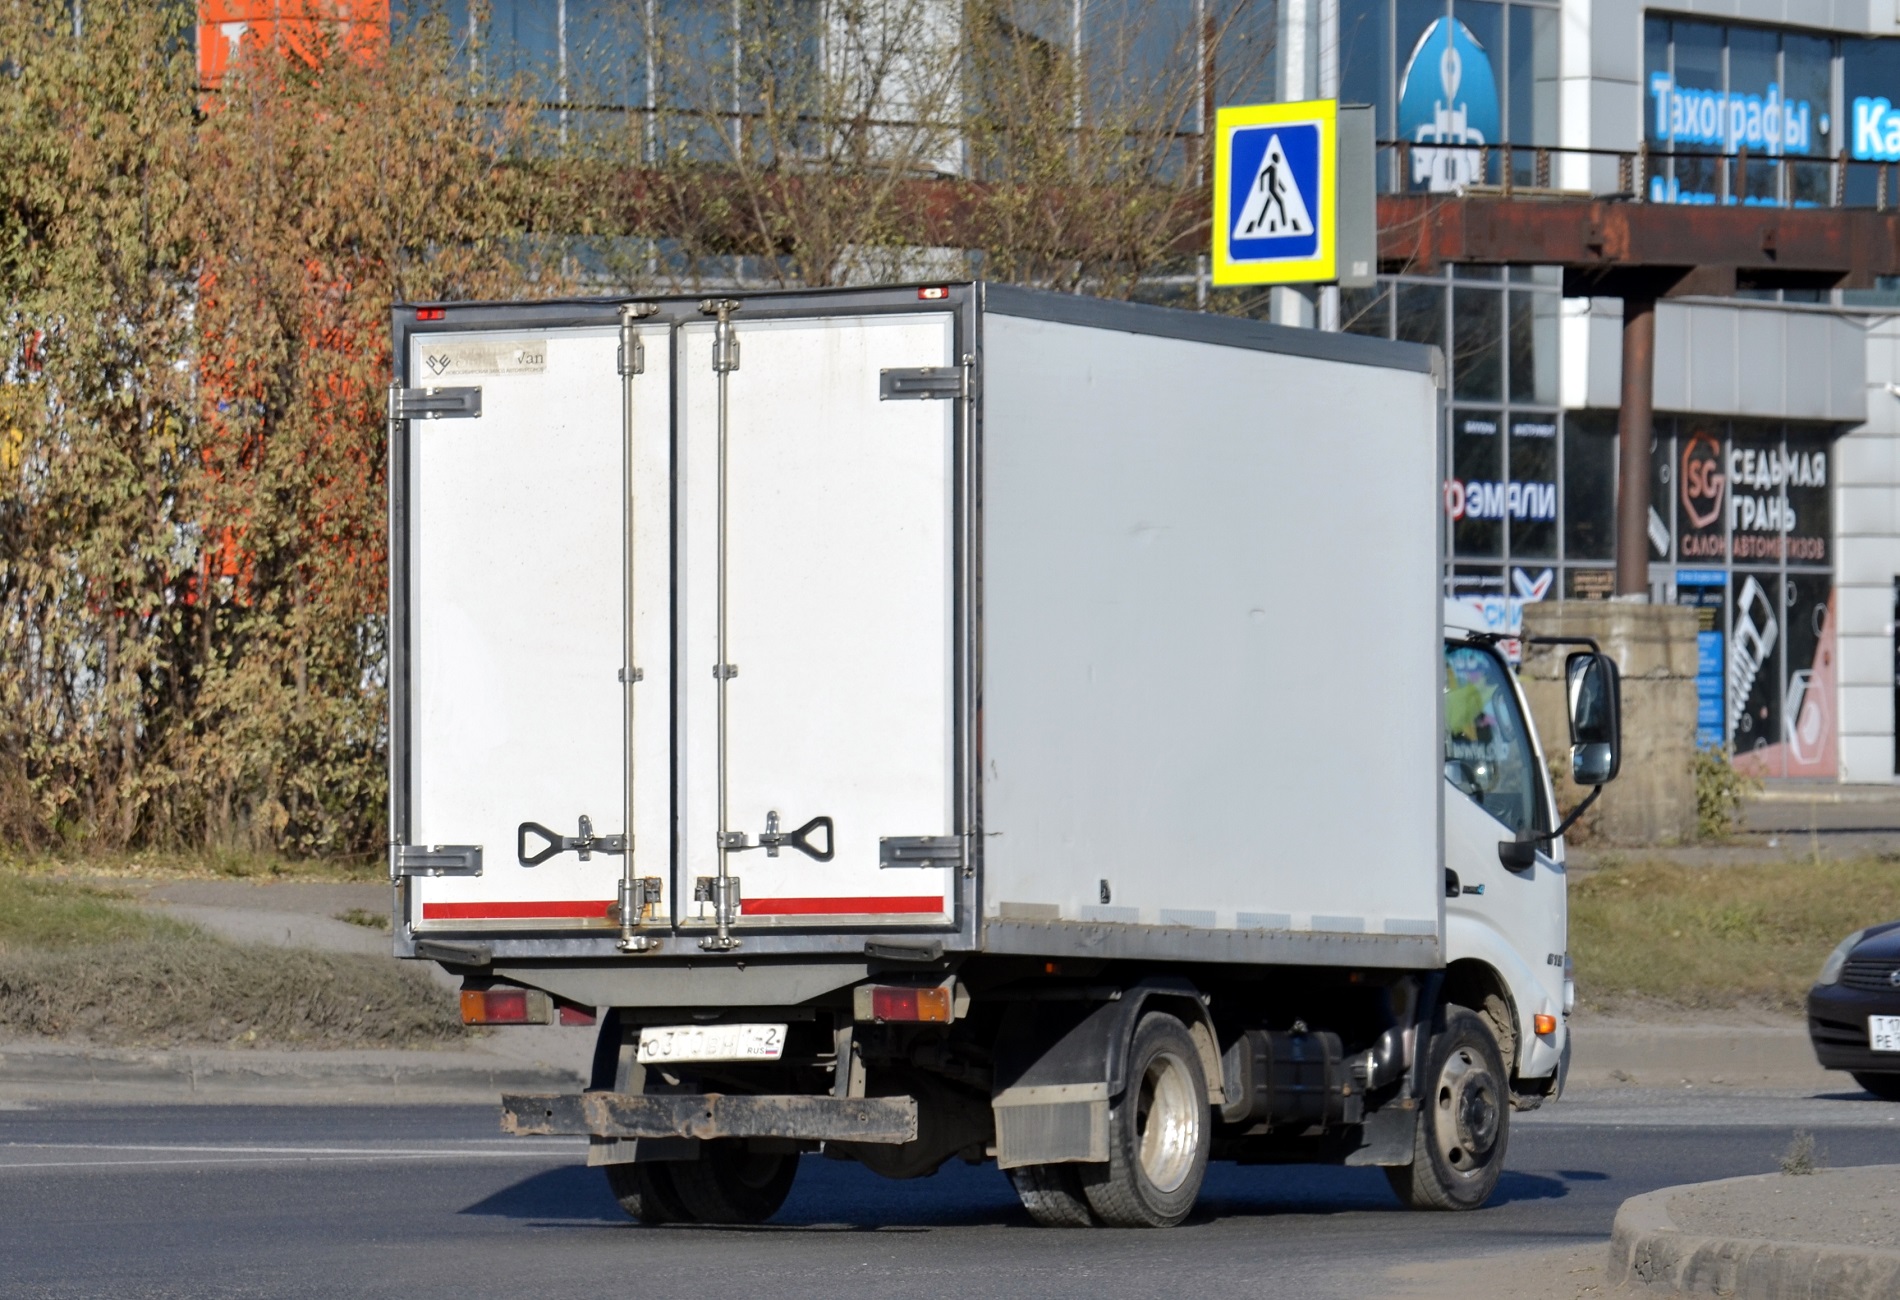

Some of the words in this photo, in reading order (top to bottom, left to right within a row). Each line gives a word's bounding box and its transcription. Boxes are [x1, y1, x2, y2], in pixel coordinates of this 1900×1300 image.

[1652, 77, 1808, 160] Тахографы
[1730, 449, 1826, 490] СЕДЬМАЯ
[1731, 495, 1796, 532] ГРАНЬ
[1682, 534, 1725, 556] САЛОН
